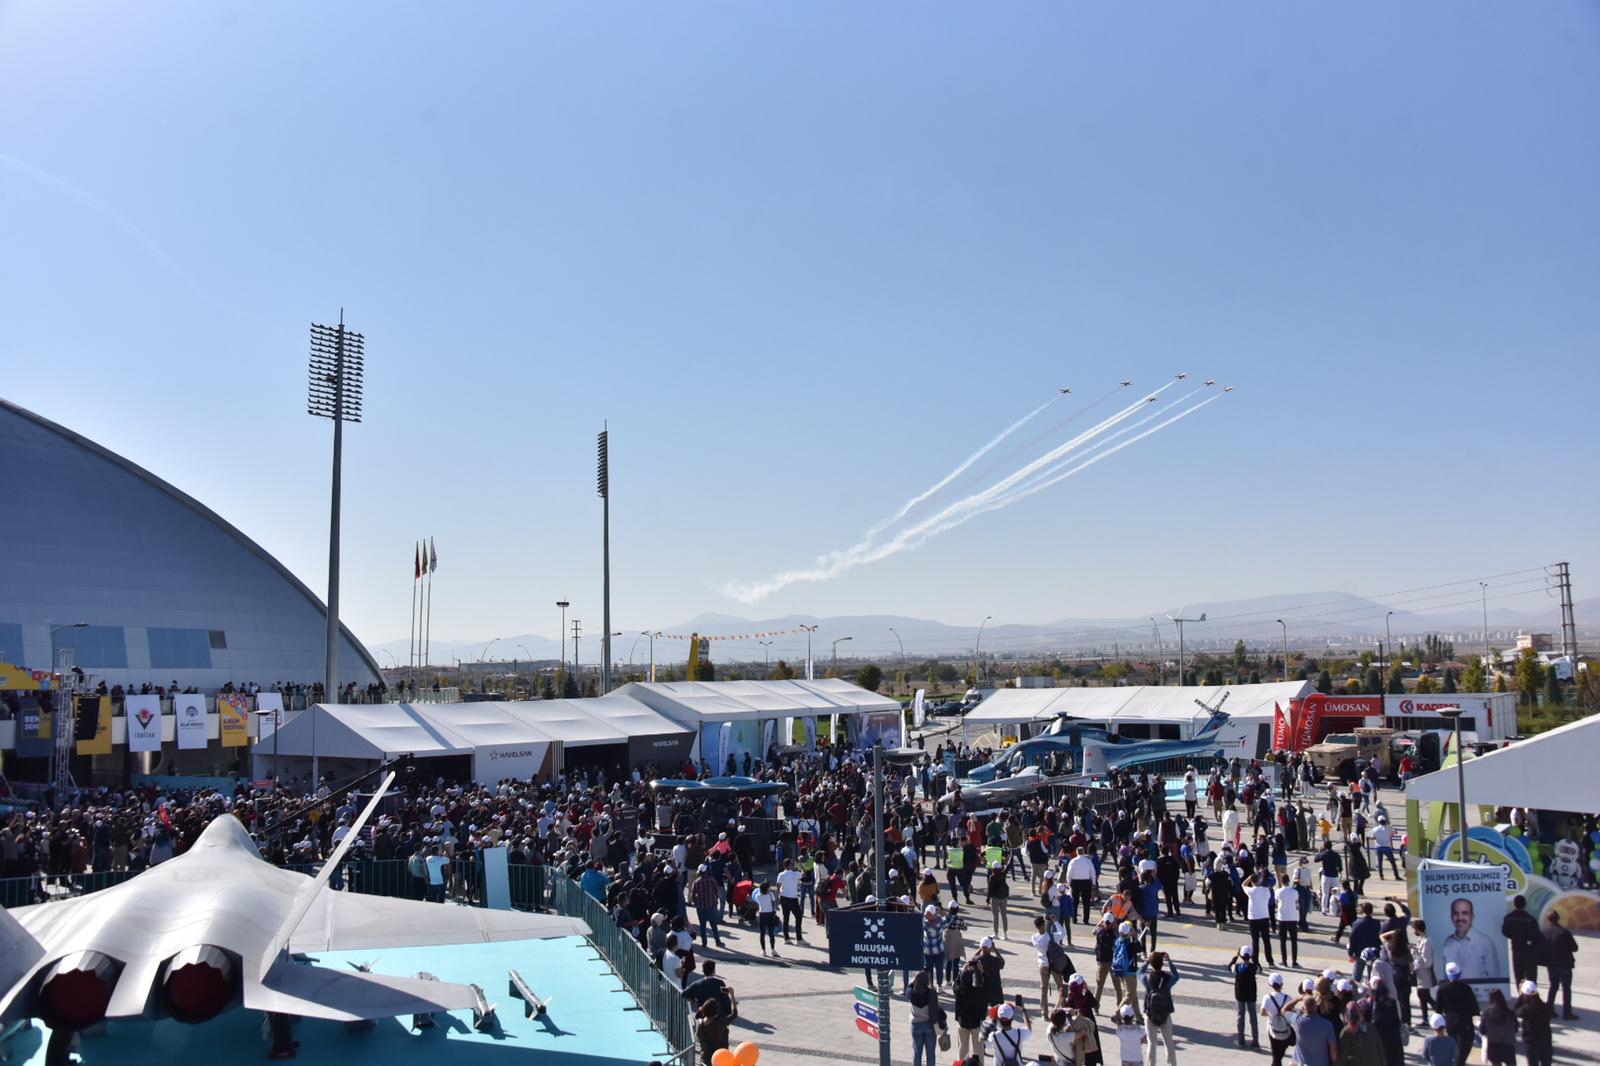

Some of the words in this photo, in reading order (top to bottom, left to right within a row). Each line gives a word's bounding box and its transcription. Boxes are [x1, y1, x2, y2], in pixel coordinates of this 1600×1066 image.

[1324, 702, 1370, 712] ÜMOSAN
[499, 750, 532, 758] HAVELSAN
[1426, 884, 1449, 896] HOŞ
[1451, 881, 1502, 894] GELDİNİZ
[854, 943, 895, 954] BULUŞMA
[851, 955, 888, 965] NOKTASI
